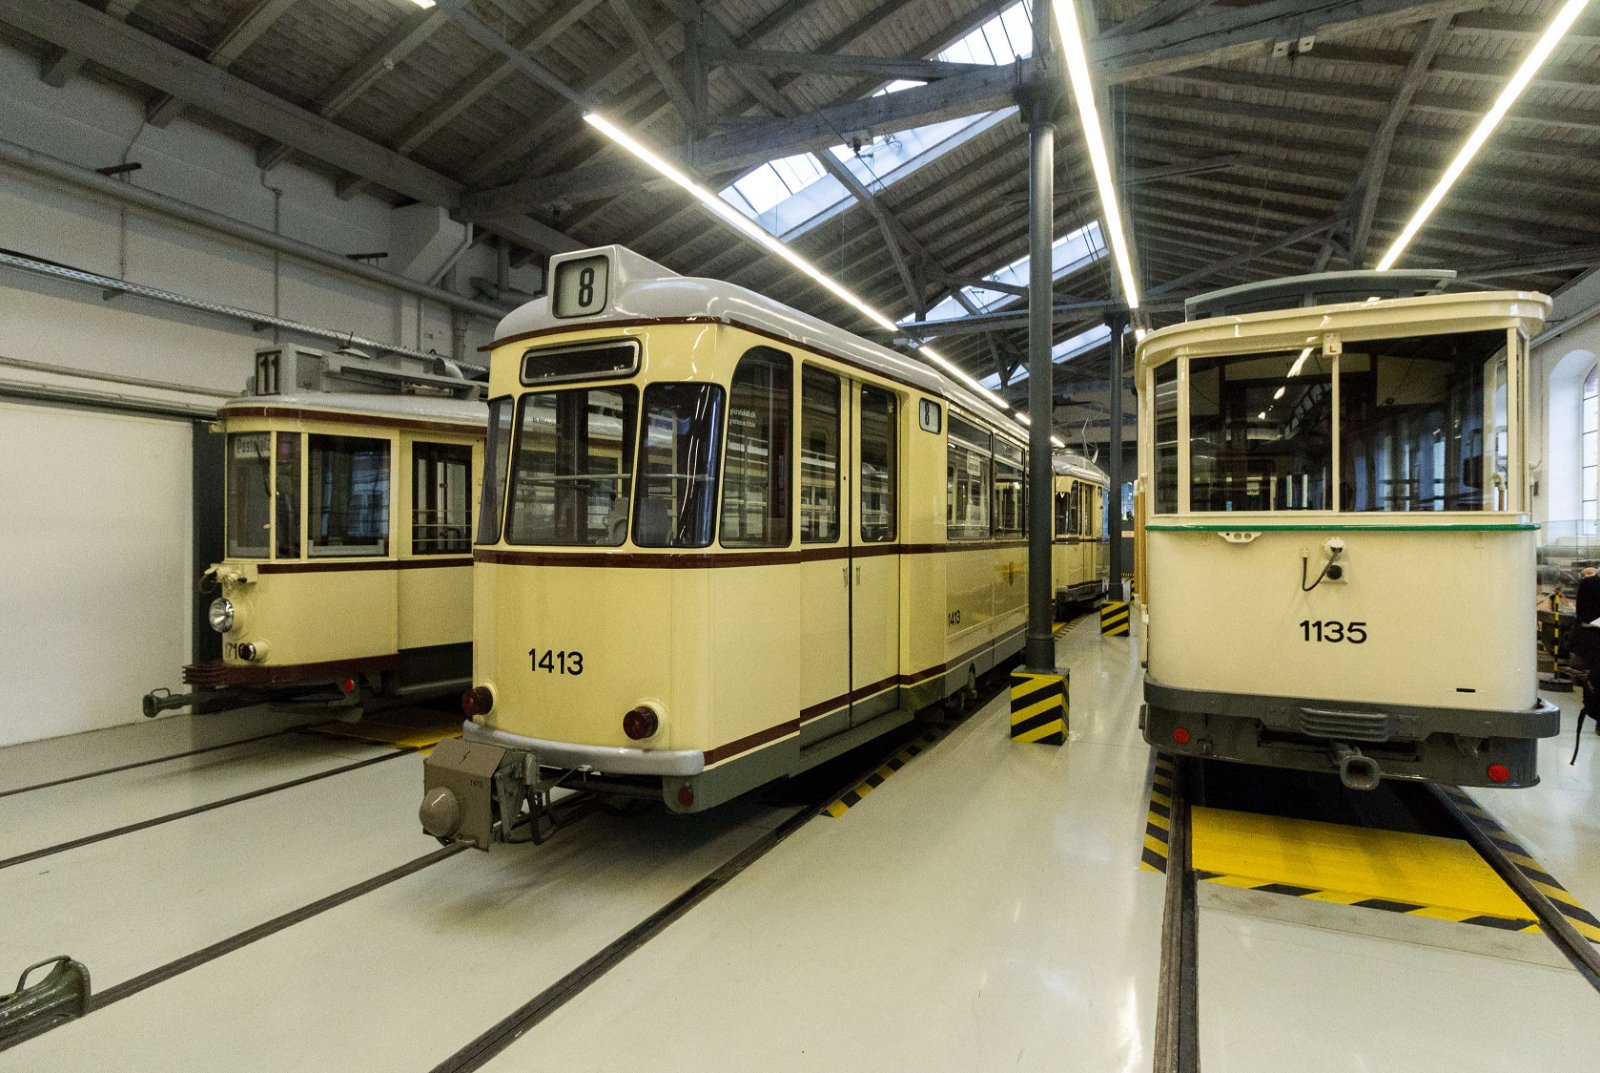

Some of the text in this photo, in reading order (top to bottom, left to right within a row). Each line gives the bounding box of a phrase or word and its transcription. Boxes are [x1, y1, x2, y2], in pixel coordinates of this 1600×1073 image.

[579, 267, 595, 308] 8
[1329, 345, 1337, 353] L
[260, 355, 280, 392] 11
[924, 401, 930, 426] 8
[948, 610, 961, 628] 1413
[1299, 620, 1367, 644] 1135
[528, 648, 584, 676] 1413
